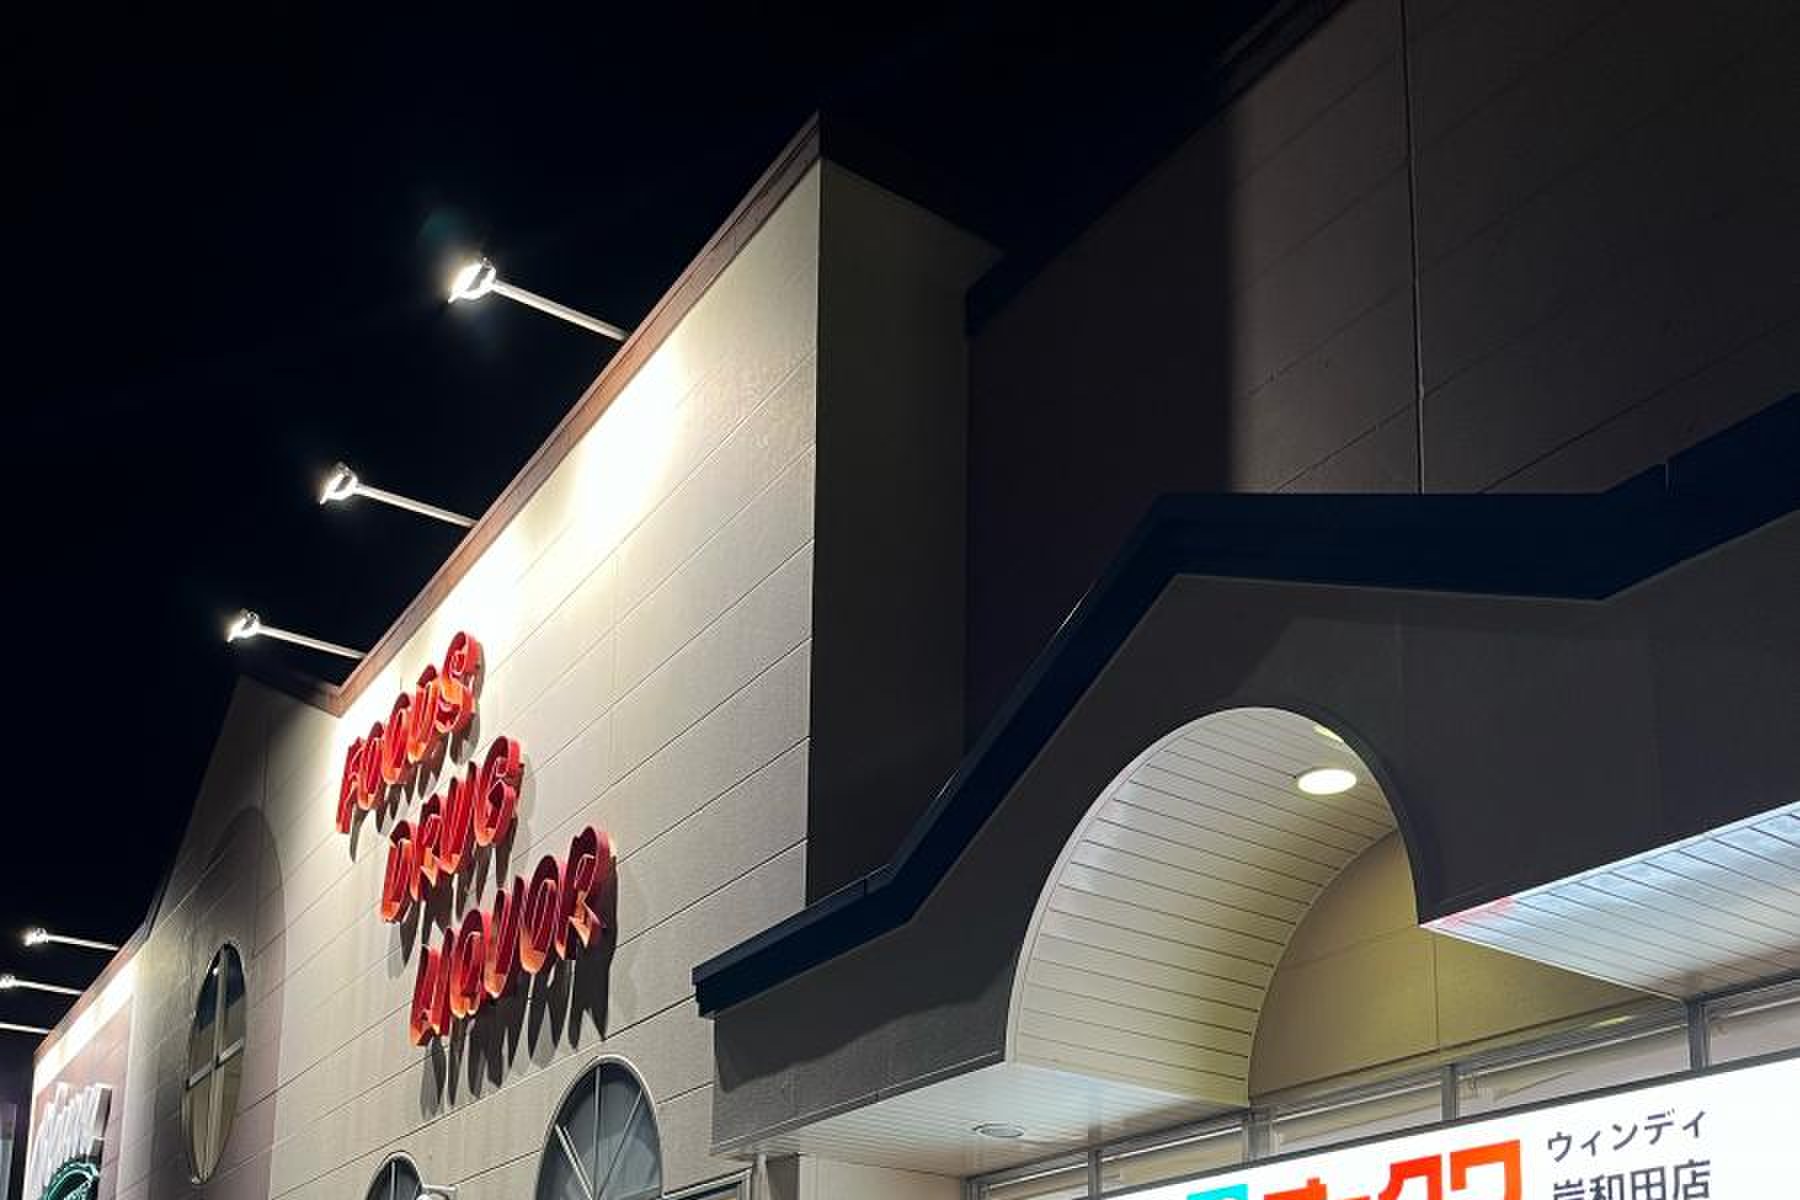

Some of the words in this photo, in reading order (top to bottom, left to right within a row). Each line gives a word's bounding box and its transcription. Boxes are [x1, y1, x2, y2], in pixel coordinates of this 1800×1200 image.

[381, 735, 526, 923] DRUG
[1548, 1109, 1706, 1163] ウィンディ
